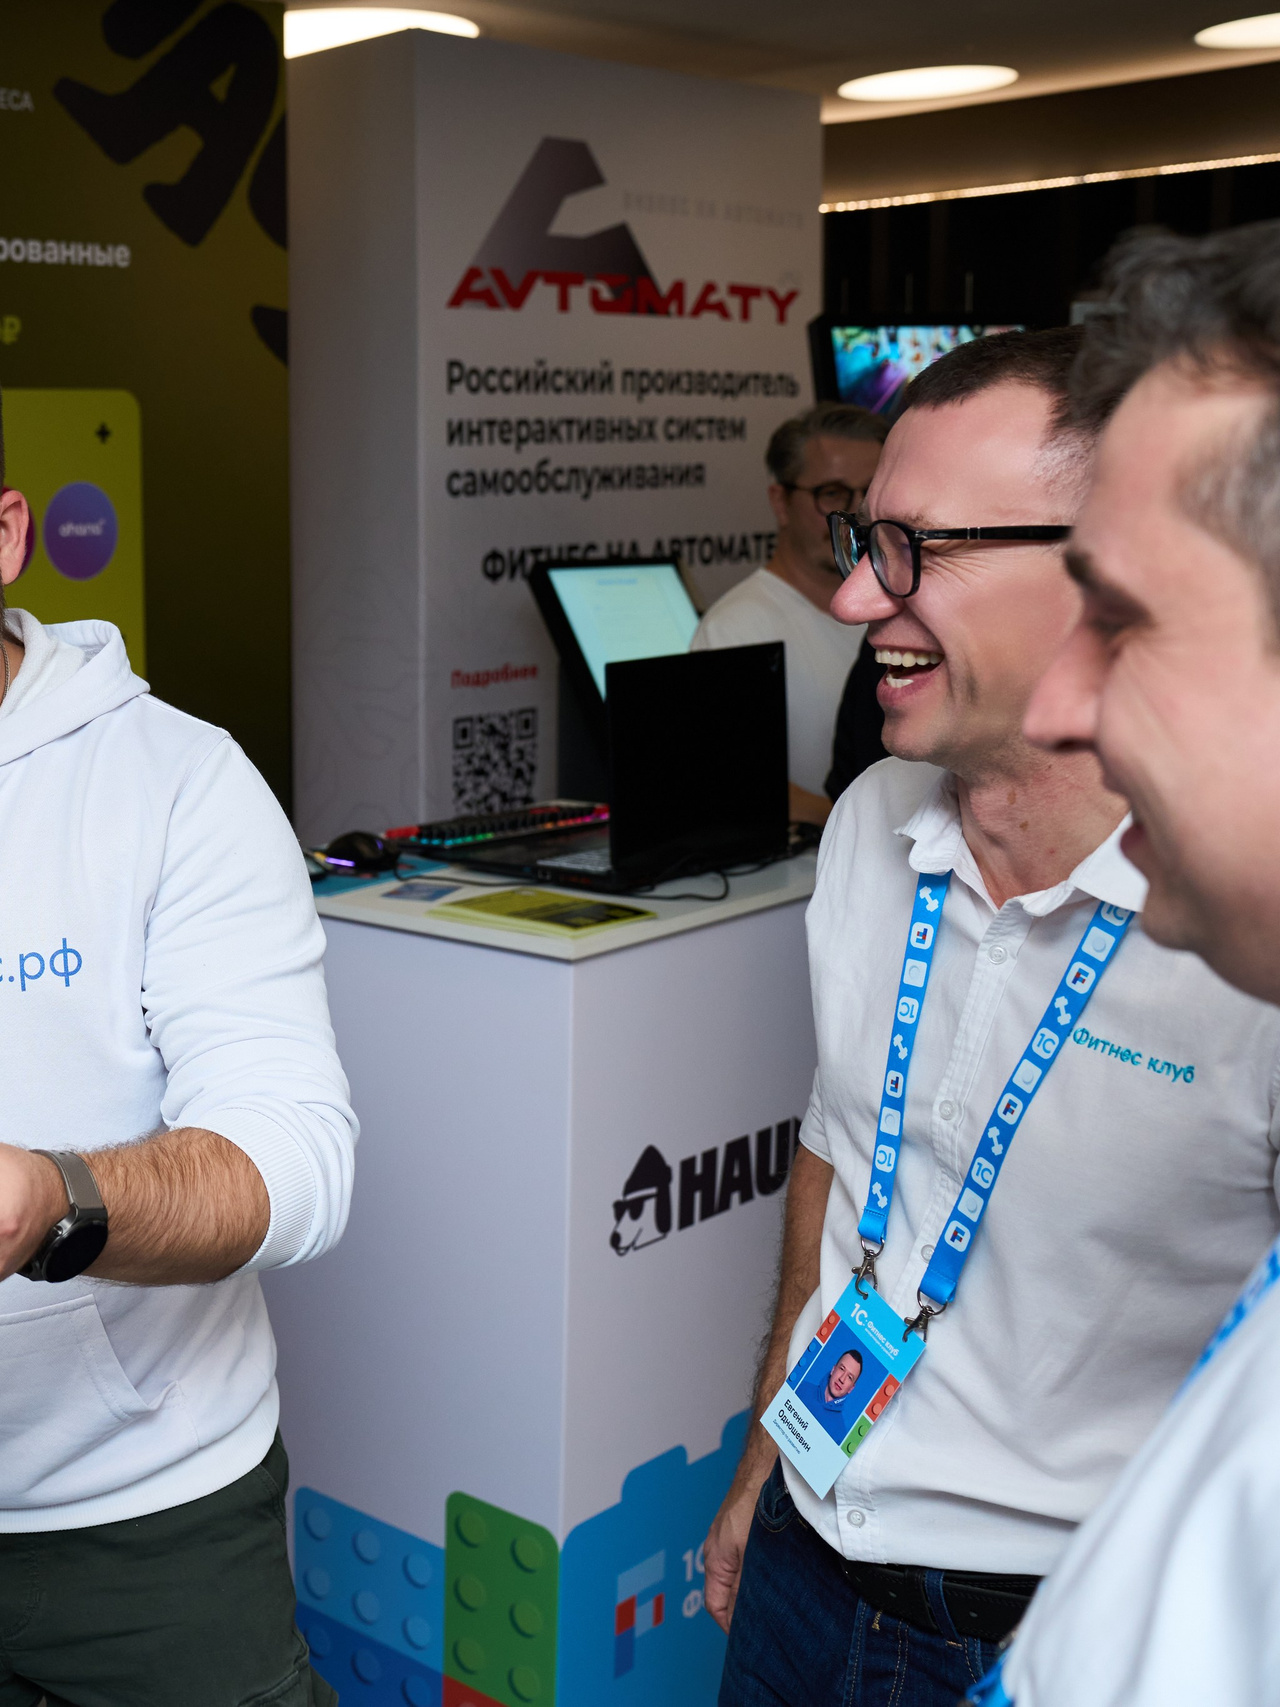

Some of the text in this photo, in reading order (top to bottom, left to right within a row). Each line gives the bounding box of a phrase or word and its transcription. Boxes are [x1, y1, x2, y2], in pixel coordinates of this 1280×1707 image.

[446, 266, 800, 325] AVTOMATY
[447, 359, 800, 401] Российский производитель
[447, 415, 746, 452] интерактивных систем
[447, 458, 705, 500] самообслуживания
[451, 661, 538, 689] Подробнее
[1147, 1057, 1195, 1083] клуб
[678, 1115, 803, 1232] HAU
[777, 1409, 811, 1452] Одношевин
[784, 1399, 809, 1431] Евгений
